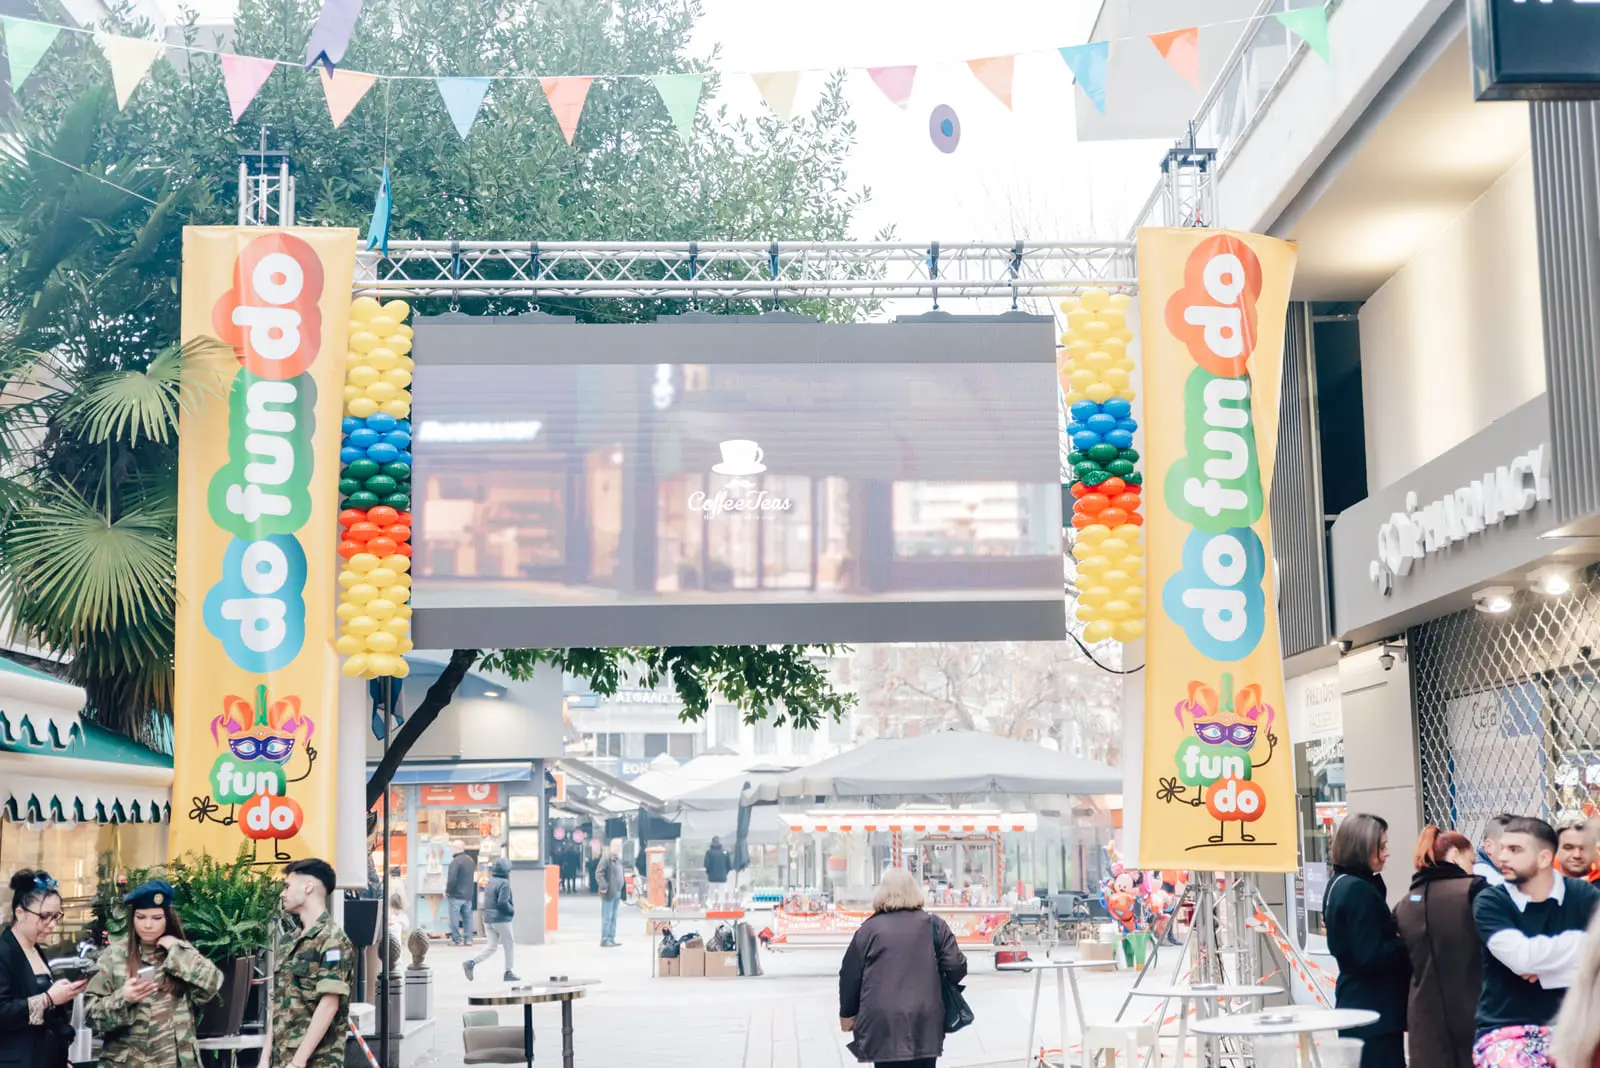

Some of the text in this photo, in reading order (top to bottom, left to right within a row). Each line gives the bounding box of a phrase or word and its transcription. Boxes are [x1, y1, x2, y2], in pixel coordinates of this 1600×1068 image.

[220, 250, 305, 653] do fun do
[1180, 253, 1250, 643] do fun do
[215, 760, 278, 797] fun
[1181, 743, 1246, 781] fun
[246, 796, 296, 831] do
[1212, 779, 1260, 815] do
